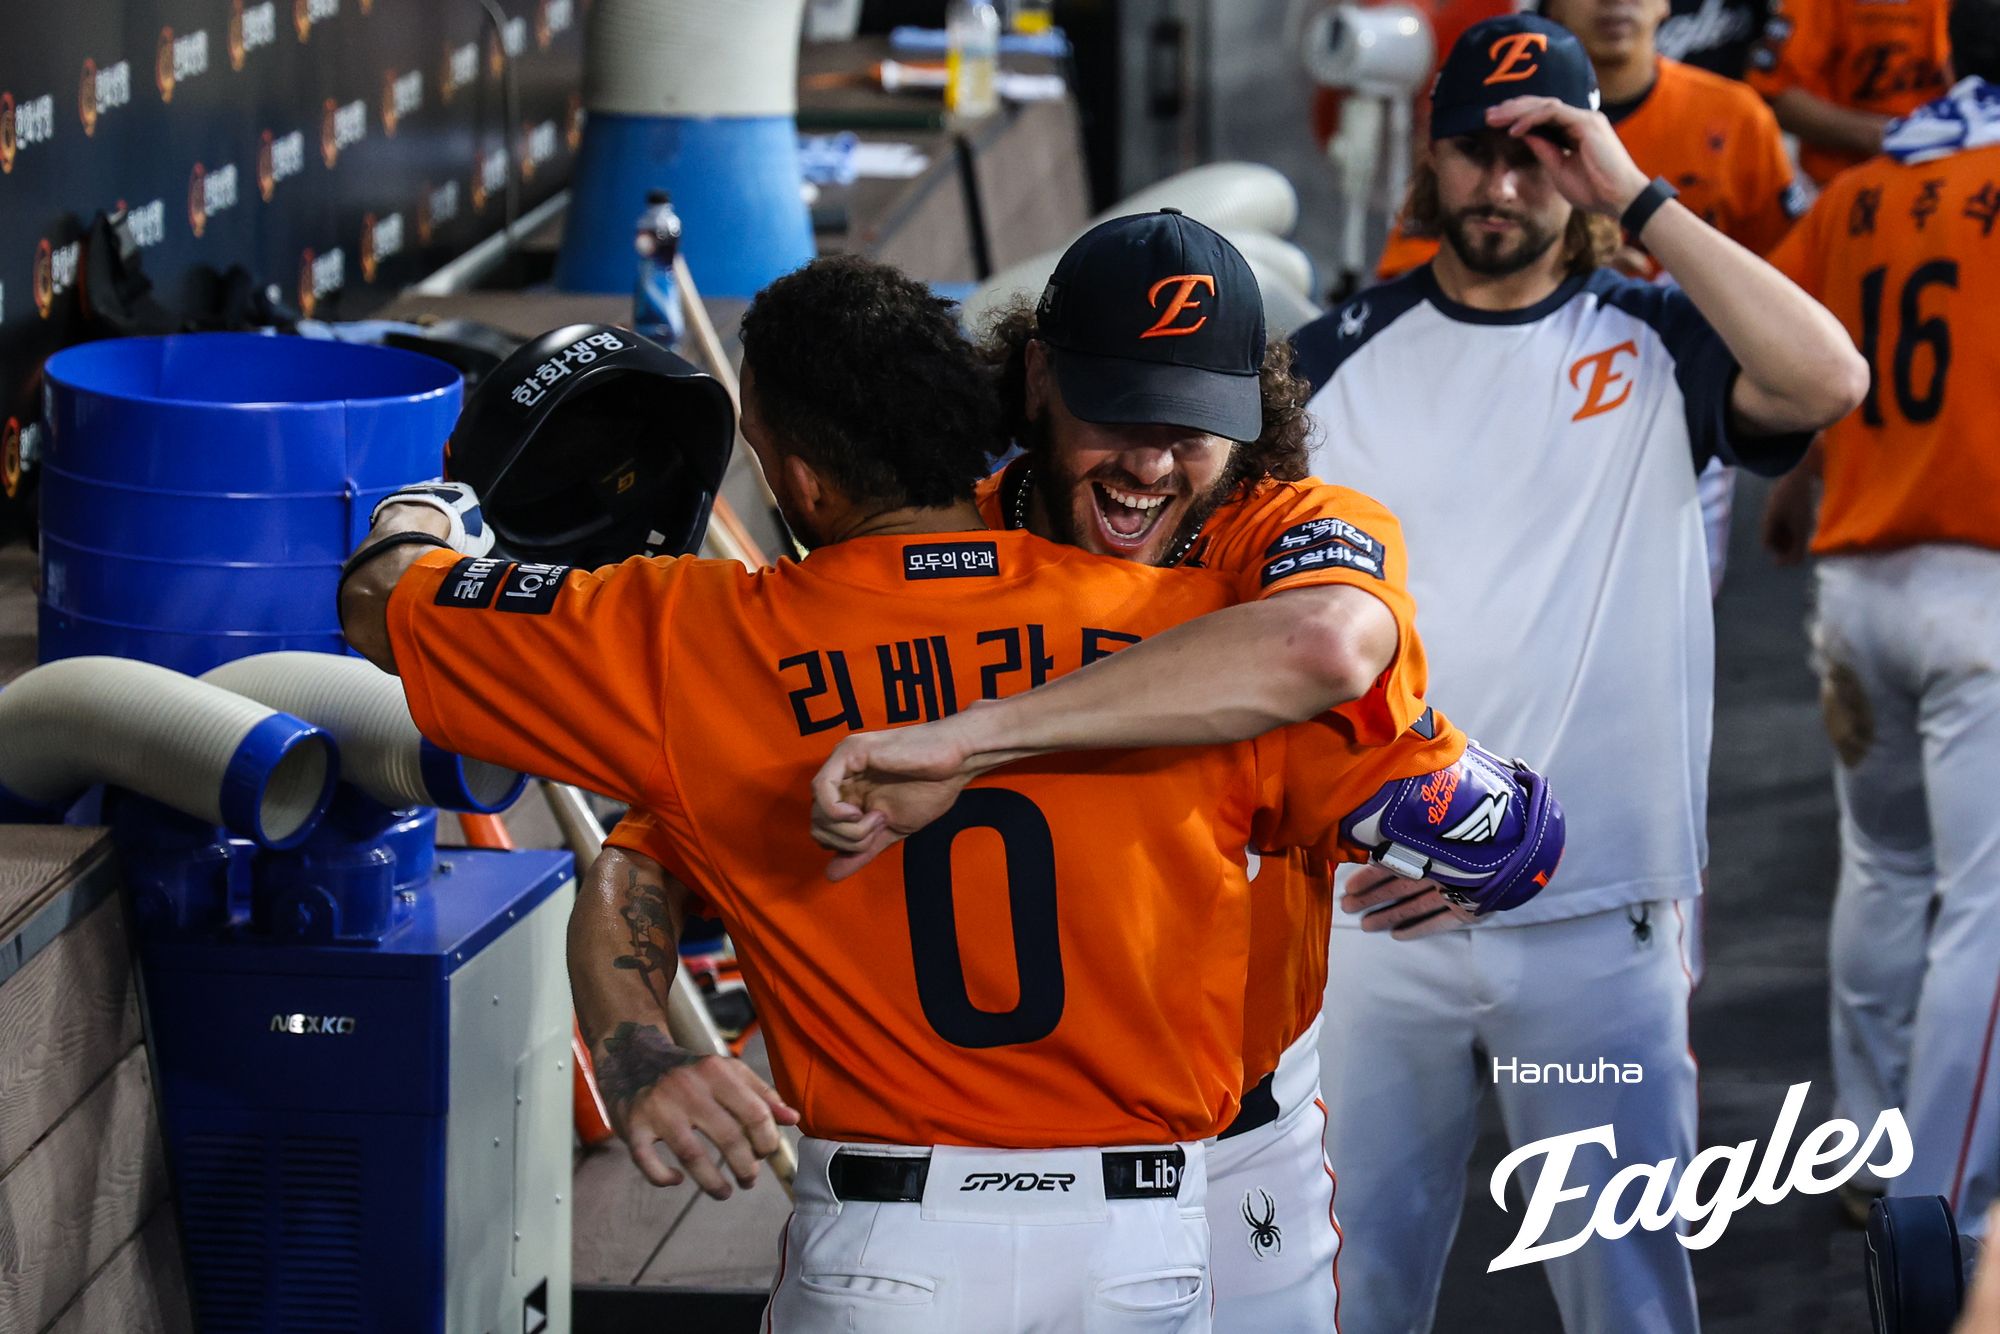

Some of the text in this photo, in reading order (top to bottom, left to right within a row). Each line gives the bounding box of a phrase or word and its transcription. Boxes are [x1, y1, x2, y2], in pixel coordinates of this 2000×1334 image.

[1484, 34, 1547, 85] E
[1138, 273, 1216, 339] E
[511, 332, 624, 407] 한화생명
[1860, 260, 1958, 427] 16
[1568, 340, 1639, 422] E
[908, 550, 995, 571] 모두의 안과
[1428, 766, 1460, 825] Libera
[903, 787, 1066, 1049] 0
[960, 1172, 1076, 1192] SPYDER
